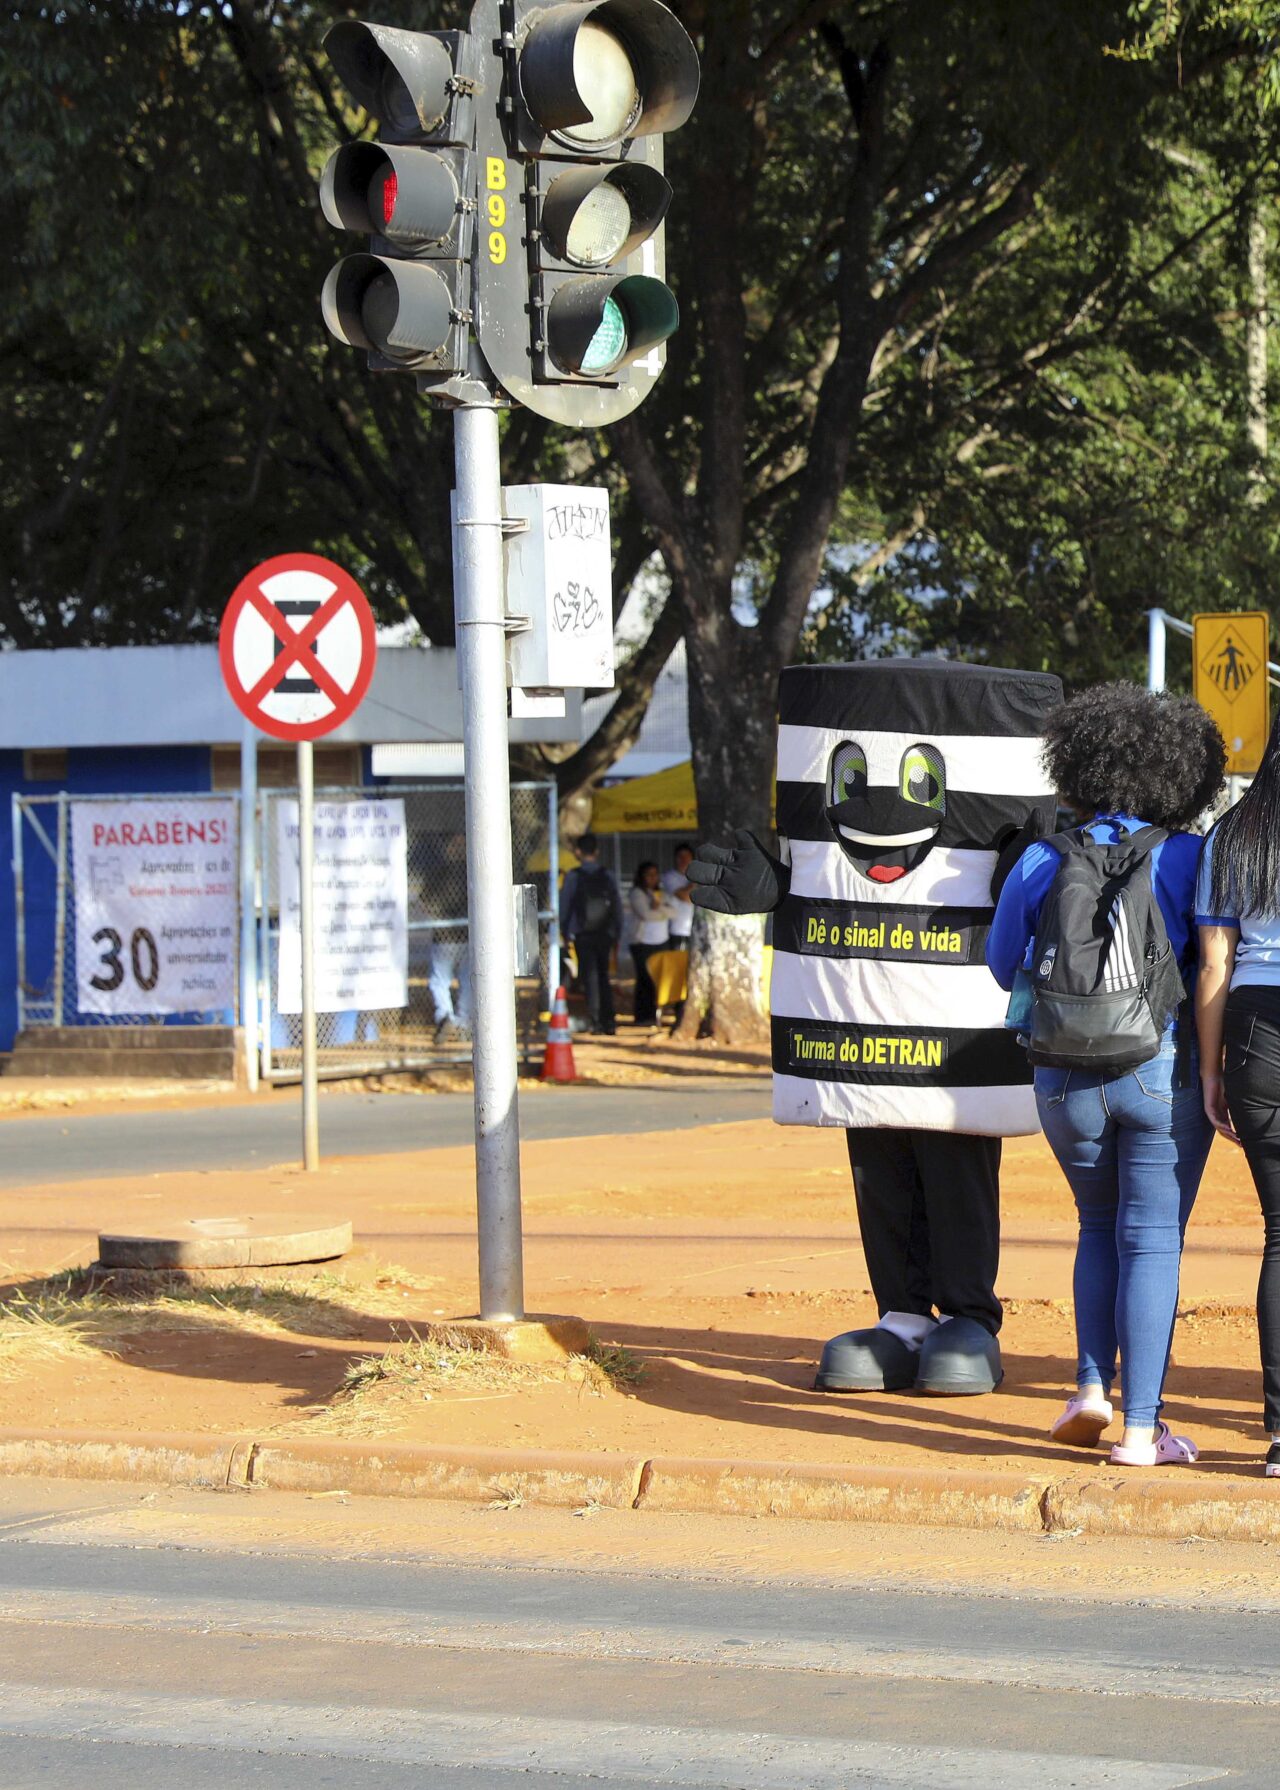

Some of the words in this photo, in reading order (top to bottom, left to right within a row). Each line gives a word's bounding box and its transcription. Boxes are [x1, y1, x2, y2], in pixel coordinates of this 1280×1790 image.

[486, 156, 507, 264] B99
[92, 815, 227, 847] PARABÉNS!
[806, 917, 827, 944] Dê
[830, 925, 840, 945] o
[843, 920, 885, 949] sinal
[890, 923, 914, 950] de
[919, 925, 962, 953] vida
[89, 927, 159, 992] 30
[794, 1033, 836, 1062] Turma
[839, 1037, 858, 1062] do
[862, 1037, 942, 1067] DETRAN
